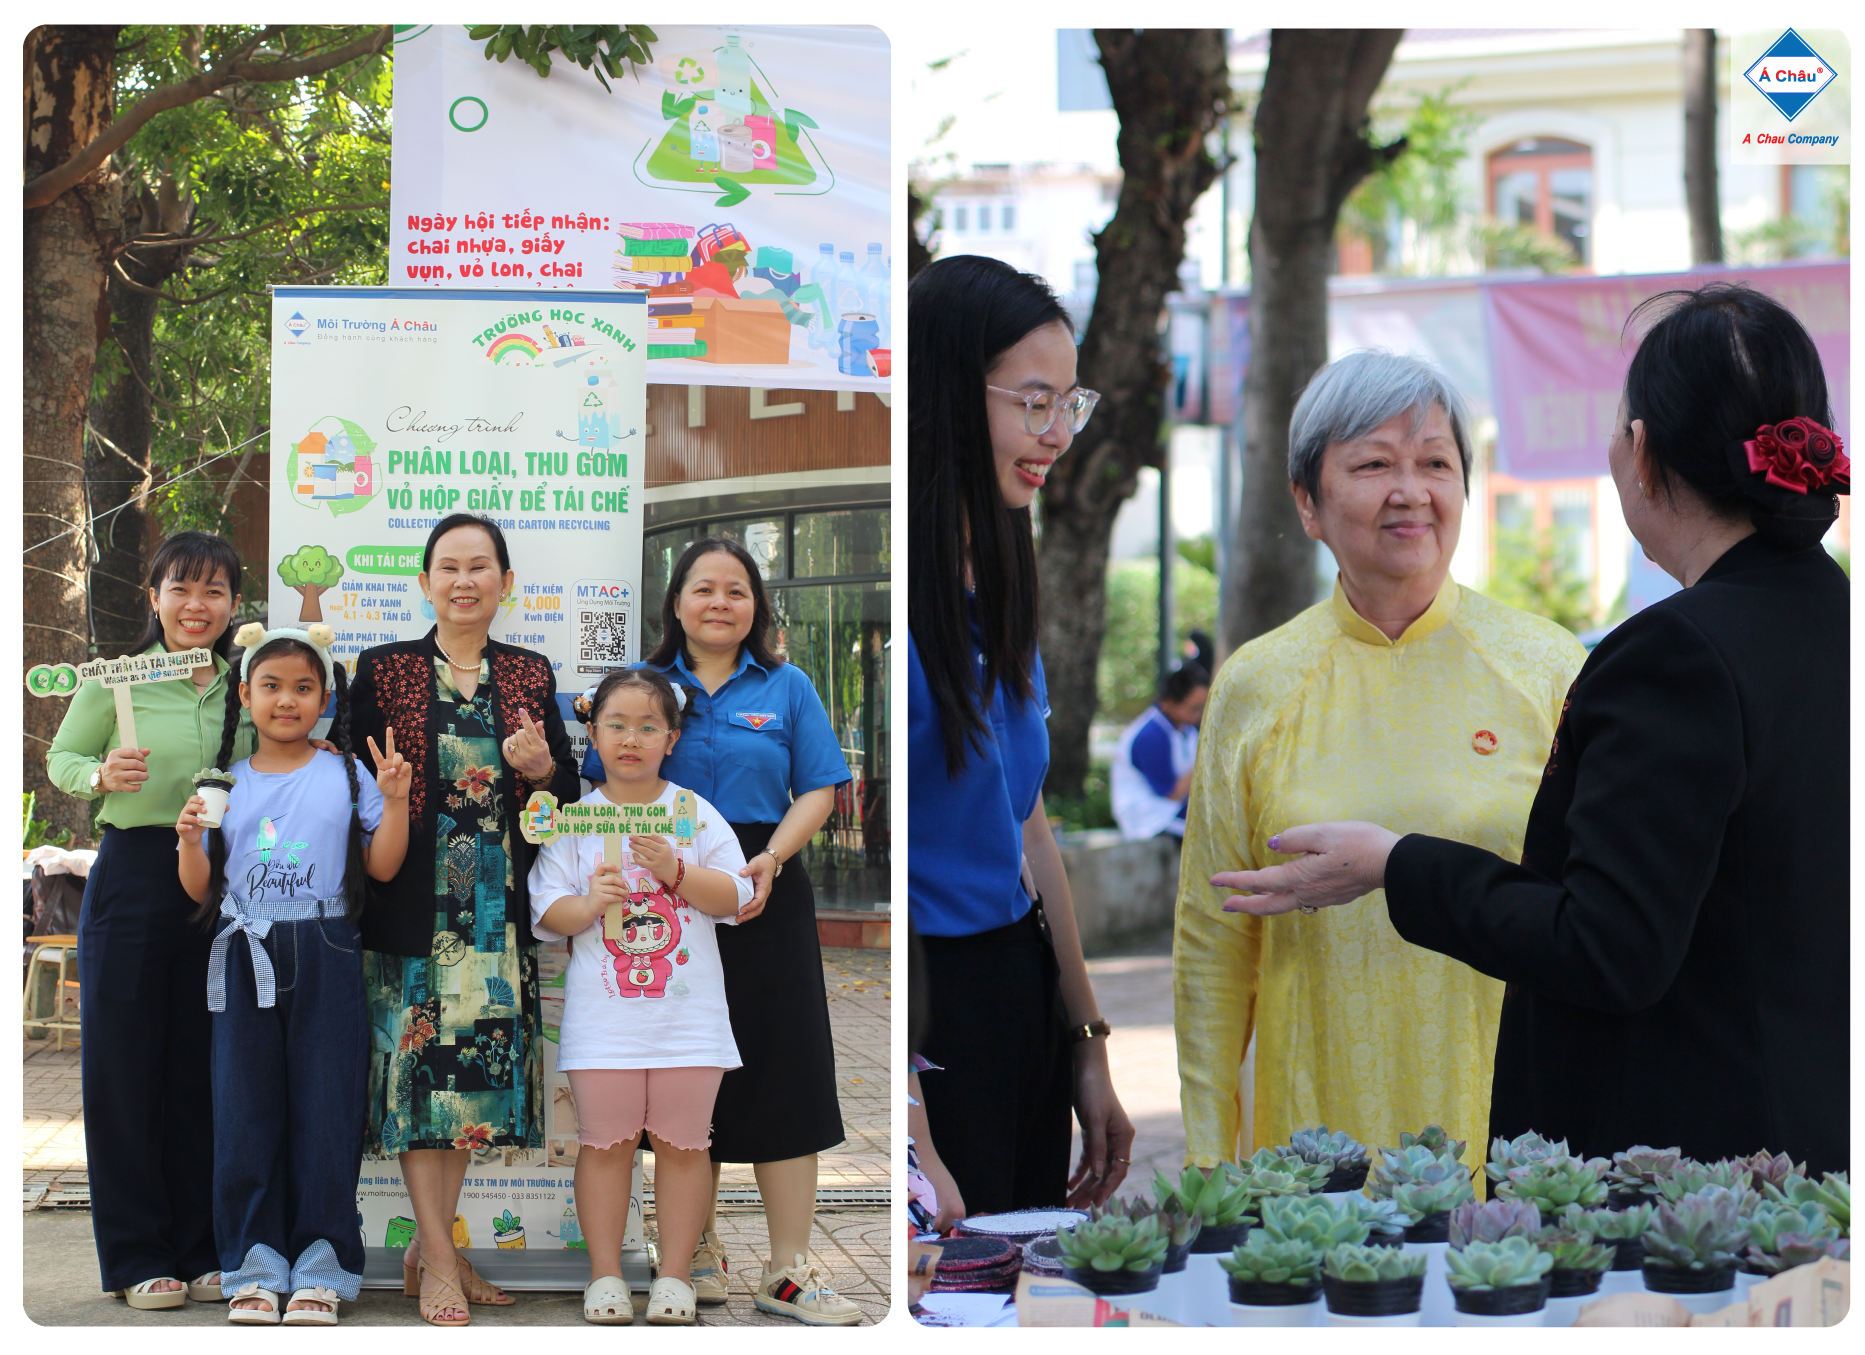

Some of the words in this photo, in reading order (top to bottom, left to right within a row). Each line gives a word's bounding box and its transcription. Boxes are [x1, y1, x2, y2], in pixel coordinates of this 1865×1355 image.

[408, 213, 457, 233] Ngày
[465, 212, 494, 233] hội
[502, 208, 545, 231] tiếp
[552, 212, 609, 233] nhận:
[407, 238, 450, 254] chai
[456, 237, 514, 256] nhựa,
[521, 232, 565, 254] giấy
[407, 265, 452, 282] vụn,
[460, 258, 484, 277] vỏ
[491, 261, 532, 279] lon,
[540, 261, 583, 277] chai
[317, 319, 338, 329] Môi
[342, 319, 386, 332] Trường
[390, 318, 400, 330] Á
[404, 320, 437, 332] Châu
[472, 309, 542, 347] TRƯỜNG
[550, 309, 585, 324] HỌC
[591, 317, 637, 353] XANH
[386, 406, 464, 443] Chương
[465, 412, 524, 433] trình
[388, 446, 451, 474] PHÂN
[460, 451, 517, 480] LOẠI,
[525, 452, 568, 476] THU
[577, 452, 628, 477] GOM
[387, 481, 412, 510] VỎ
[419, 484, 460, 515] HỘP
[467, 481, 513, 511] GIẤY
[520, 481, 548, 511] ĐỂ
[552, 486, 584, 511] TÁI
[591, 485, 630, 513] CHẾ
[388, 518, 442, 528] COLLECTIO
[498, 519, 515, 529] FOR
[518, 519, 556, 530] CARTON
[559, 520, 610, 531] RECYCLING
[354, 554, 373, 567] KHI
[377, 552, 394, 567] TÁI
[398, 551, 422, 567] CHẾ
[342, 579, 363, 591] GIẢM
[366, 582, 384, 592] KHAI
[387, 582, 408, 592] THÁC
[523, 583, 540, 594] TIẾT
[542, 584, 563, 596] KIỆM
[577, 586, 629, 598] MTAC+
[342, 593, 358, 607] 17
[361, 597, 377, 607] CÂY
[380, 599, 401, 608] XANH
[524, 596, 560, 611] 4,000
[344, 610, 356, 620] 4.1
[366, 611, 380, 620] 4.3
[382, 610, 398, 621] TẤN
[524, 613, 542, 621] Kwh
[544, 611, 564, 623] ĐIỆN
[356, 631, 377, 642] PHÁT
[379, 631, 397, 642] THẢI
[505, 632, 521, 643] TIẾT
[524, 633, 545, 645] KIỆM
[332, 643, 346, 653] KHÍ
[82, 662, 107, 677] CHẤT
[110, 659, 132, 673] THẢI
[135, 658, 148, 670] LÀ
[150, 656, 165, 669] TÀI
[168, 651, 208, 666] NGUYÊN
[552, 659, 562, 671] ẤP
[104, 675, 128, 684] Waste
[564, 803, 591, 817] PHÂN
[594, 806, 620, 819] LOẠI,
[623, 806, 643, 817] THU
[647, 806, 666, 817] GOM
[557, 819, 570, 833] VỎ
[574, 820, 593, 836] HỘP
[596, 820, 615, 833] SỮA
[619, 818, 632, 833] ĐỂ
[635, 820, 651, 833] TÁI
[654, 818, 673, 833] CHẾ
[247, 863, 316, 902] Beautiful
[358, 1176, 373, 1185] òng
[375, 1177, 388, 1185] liên
[390, 1177, 401, 1186] hệ:
[474, 1179, 484, 1187] SX
[486, 1179, 497, 1187] TM
[500, 1179, 508, 1187] DV
[511, 1178, 525, 1187] MÔI
[527, 1178, 555, 1187] TRƯỜNG
[558, 1178, 562, 1187] Á
[565, 1180, 574, 1188] CH
